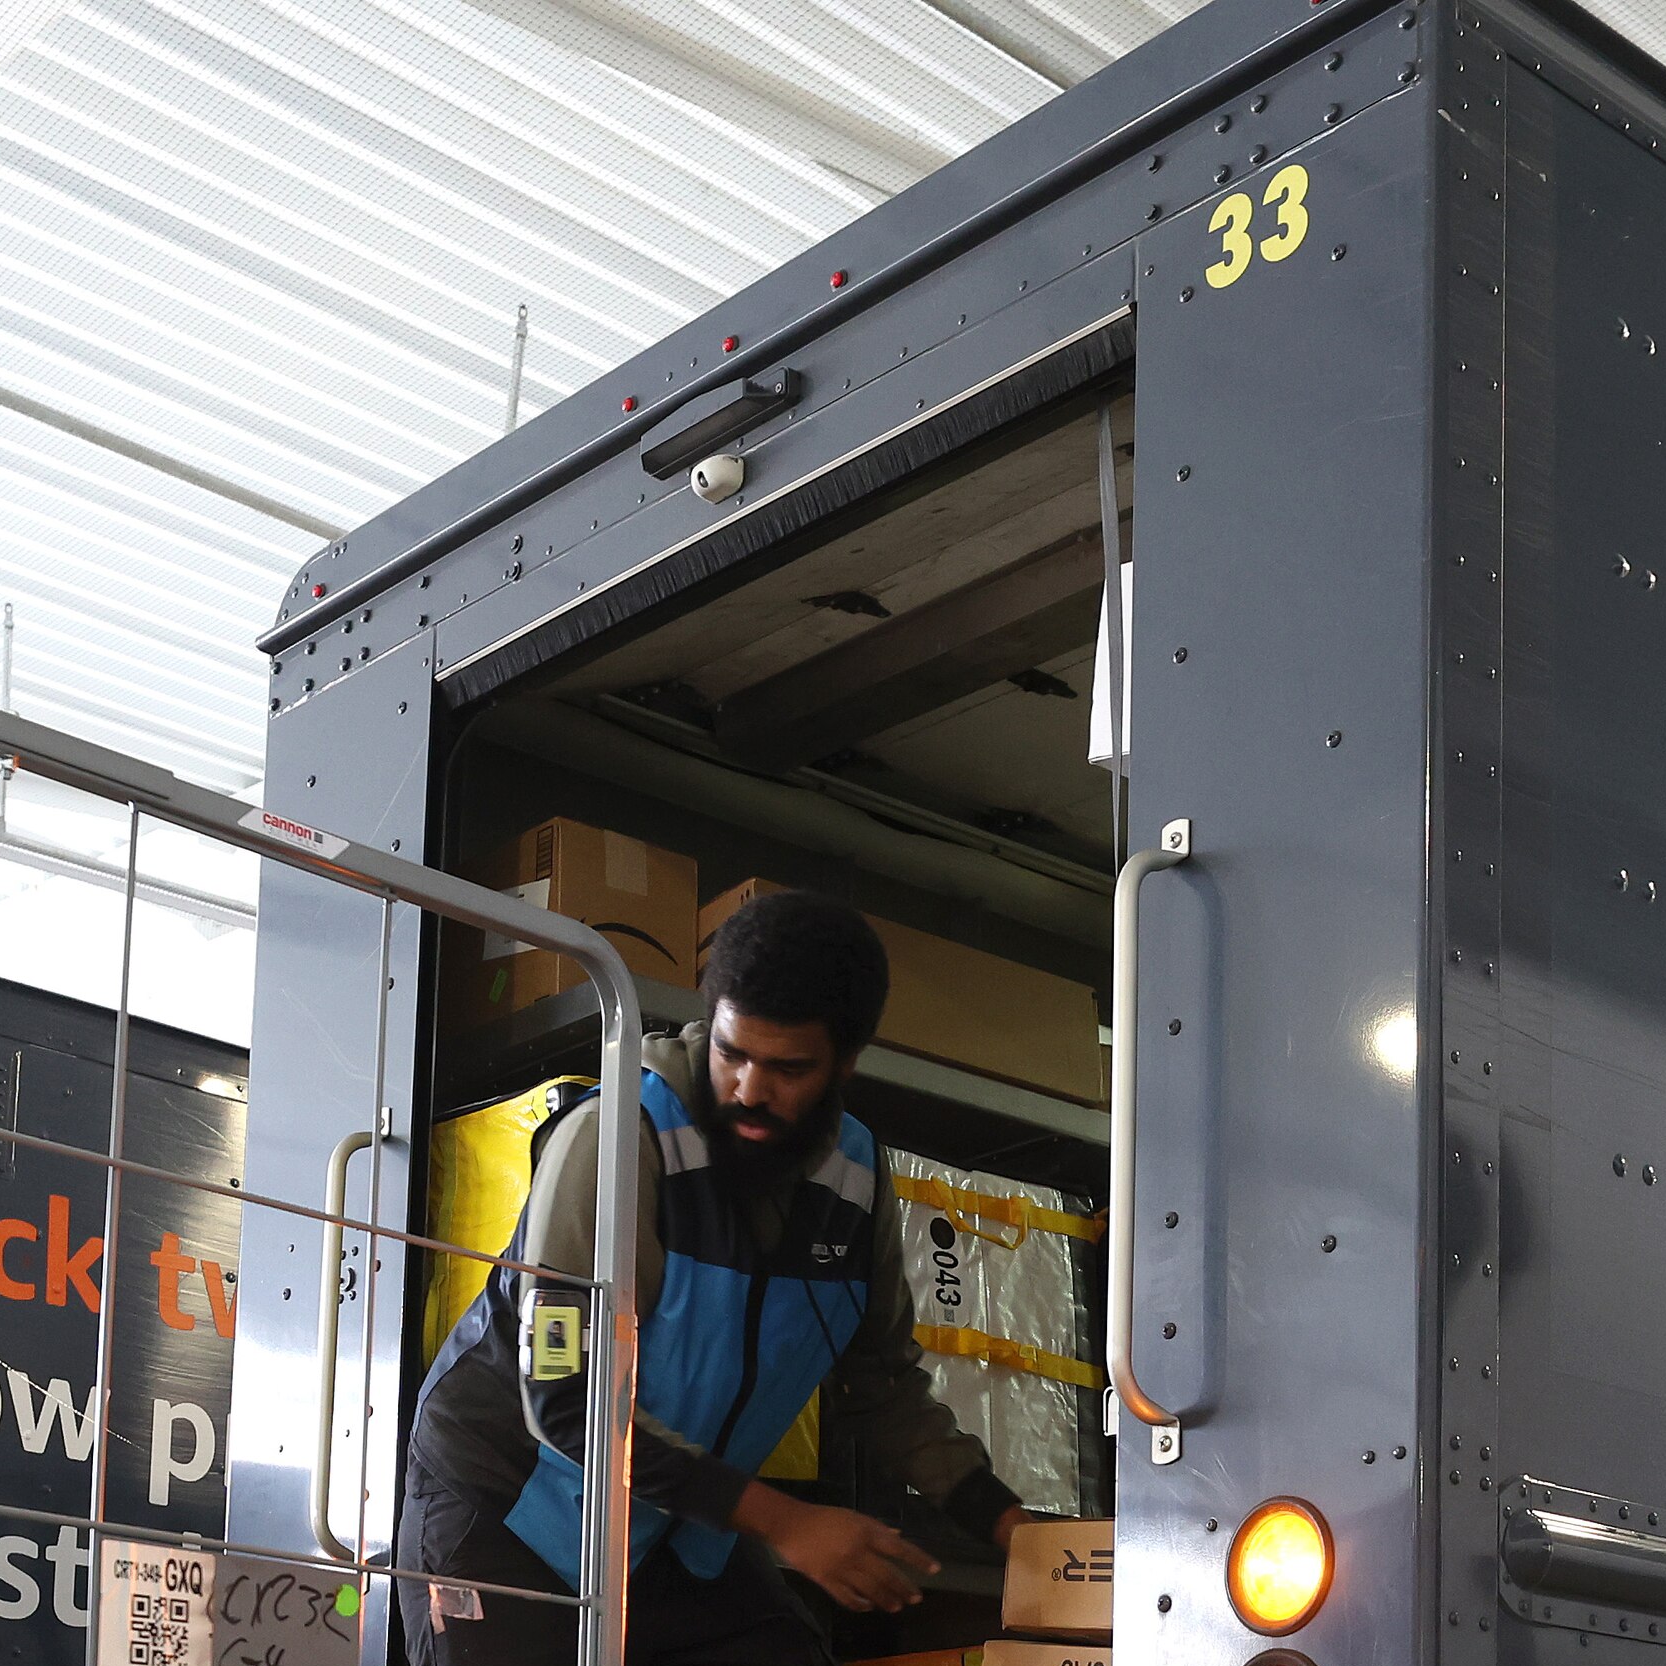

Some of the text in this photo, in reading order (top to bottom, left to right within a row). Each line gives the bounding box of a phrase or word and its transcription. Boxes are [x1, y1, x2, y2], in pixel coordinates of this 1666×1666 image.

[1205, 164, 1309, 289] 33
[263, 813, 312, 840] cannon
[933, 1251, 961, 1307] 043
